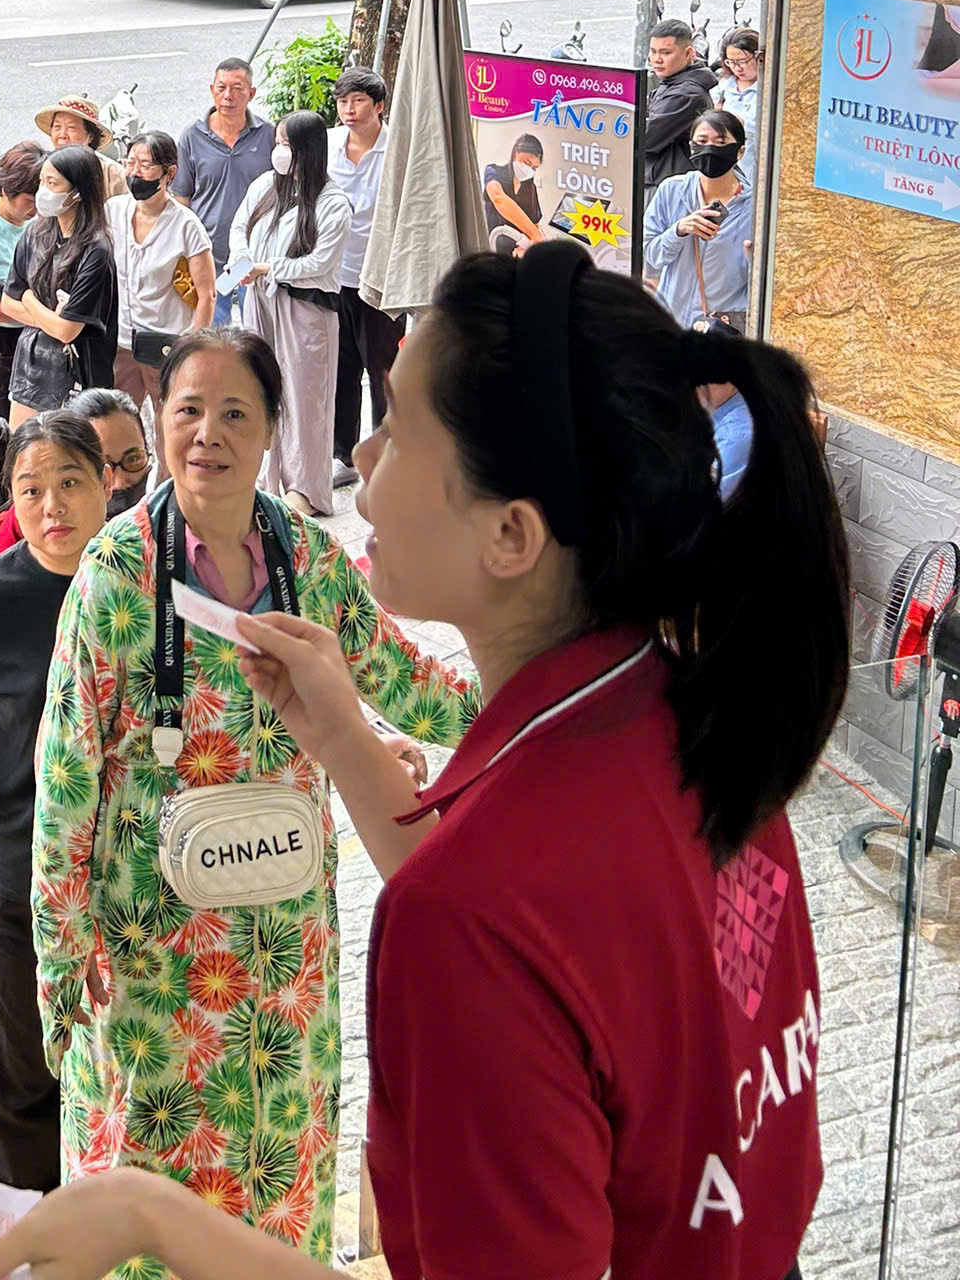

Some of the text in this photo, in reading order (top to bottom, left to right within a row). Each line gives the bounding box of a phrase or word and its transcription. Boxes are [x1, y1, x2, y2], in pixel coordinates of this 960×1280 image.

[549, 73, 624, 96] 0968.496.368
[478, 92, 510, 108] Beauty
[530, 89, 630, 138] TẦNG 6
[828, 97, 959, 139] JULI BEAUTY
[560, 141, 611, 171] TRIỆT
[863, 135, 914, 161] TRIỆT
[556, 167, 614, 197] LÔNG
[892, 174, 935, 196] TẦNG 6
[580, 213, 613, 235] 99K
[200, 829, 304, 869] CHNALE
